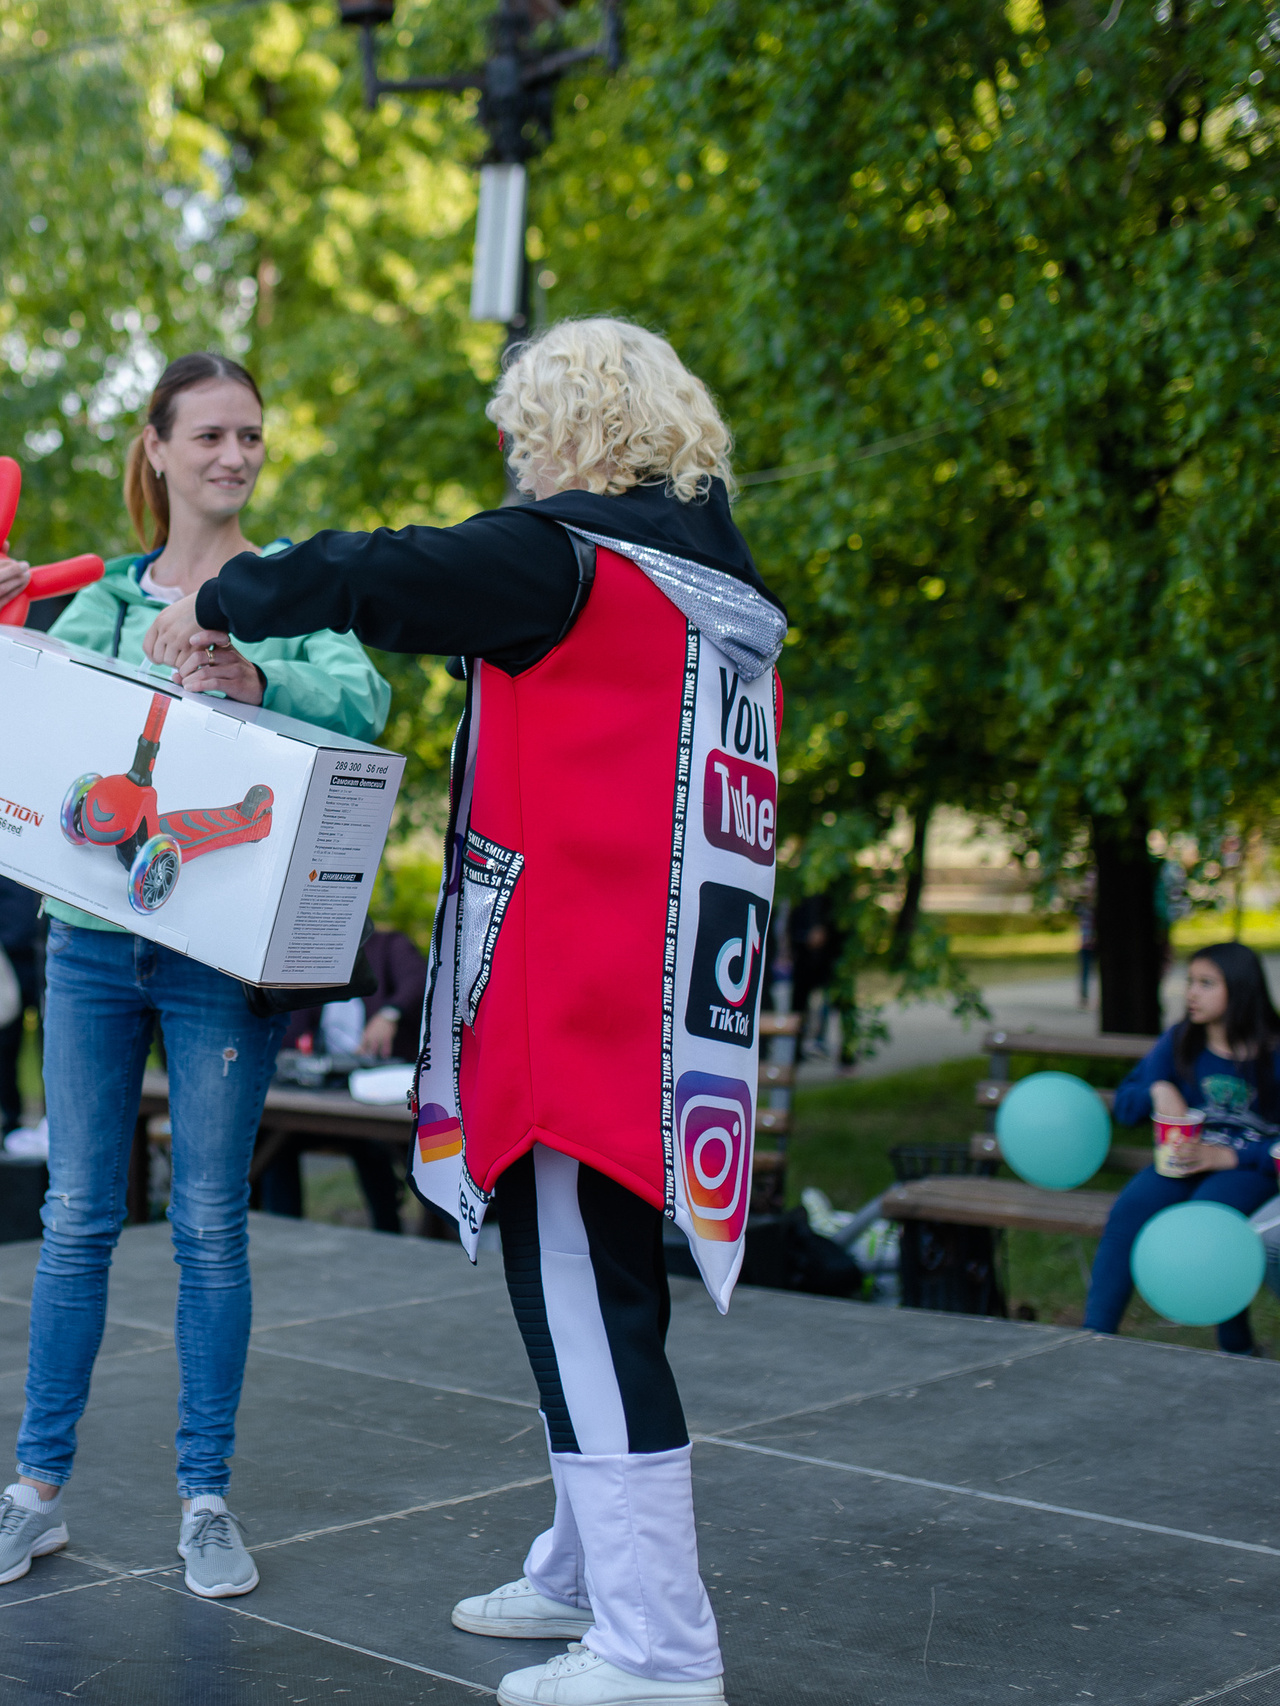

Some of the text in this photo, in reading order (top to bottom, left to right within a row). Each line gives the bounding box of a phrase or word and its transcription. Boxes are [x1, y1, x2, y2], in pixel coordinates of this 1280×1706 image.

[687, 635, 698, 669] SMILE
[684, 672, 695, 706] SMILE
[681, 710, 692, 744] SMILE
[719, 667, 769, 762] You
[349, 762, 362, 772] 300
[366, 764, 376, 773] S6
[376, 766, 388, 774] red
[678, 747, 690, 782] SMILE
[676, 785, 687, 820] SMILE
[714, 761, 774, 850] Tube
[8, 823, 22, 834] red
[673, 822, 684, 858] SMILE
[484, 842, 512, 863] SMILE
[504, 852, 524, 886] SMILE
[322, 872, 356, 882] ВНИМАНИЕ!
[469, 868, 490, 884] SMILE
[670, 860, 681, 896] SMILE
[492, 888, 510, 924] SMILE
[667, 899, 678, 934] SMILE
[484, 926, 498, 960] SMILE
[665, 937, 675, 972] SMILE
[664, 976, 673, 1012] SMILE
[663, 1014, 672, 1050] SMILE
[709, 1004, 749, 1036] TikTok
[662, 1052, 672, 1088] SMILE
[662, 1091, 672, 1127] SMILE
[662, 1129, 673, 1166] SMILE
[665, 1168, 674, 1206] SMILE
